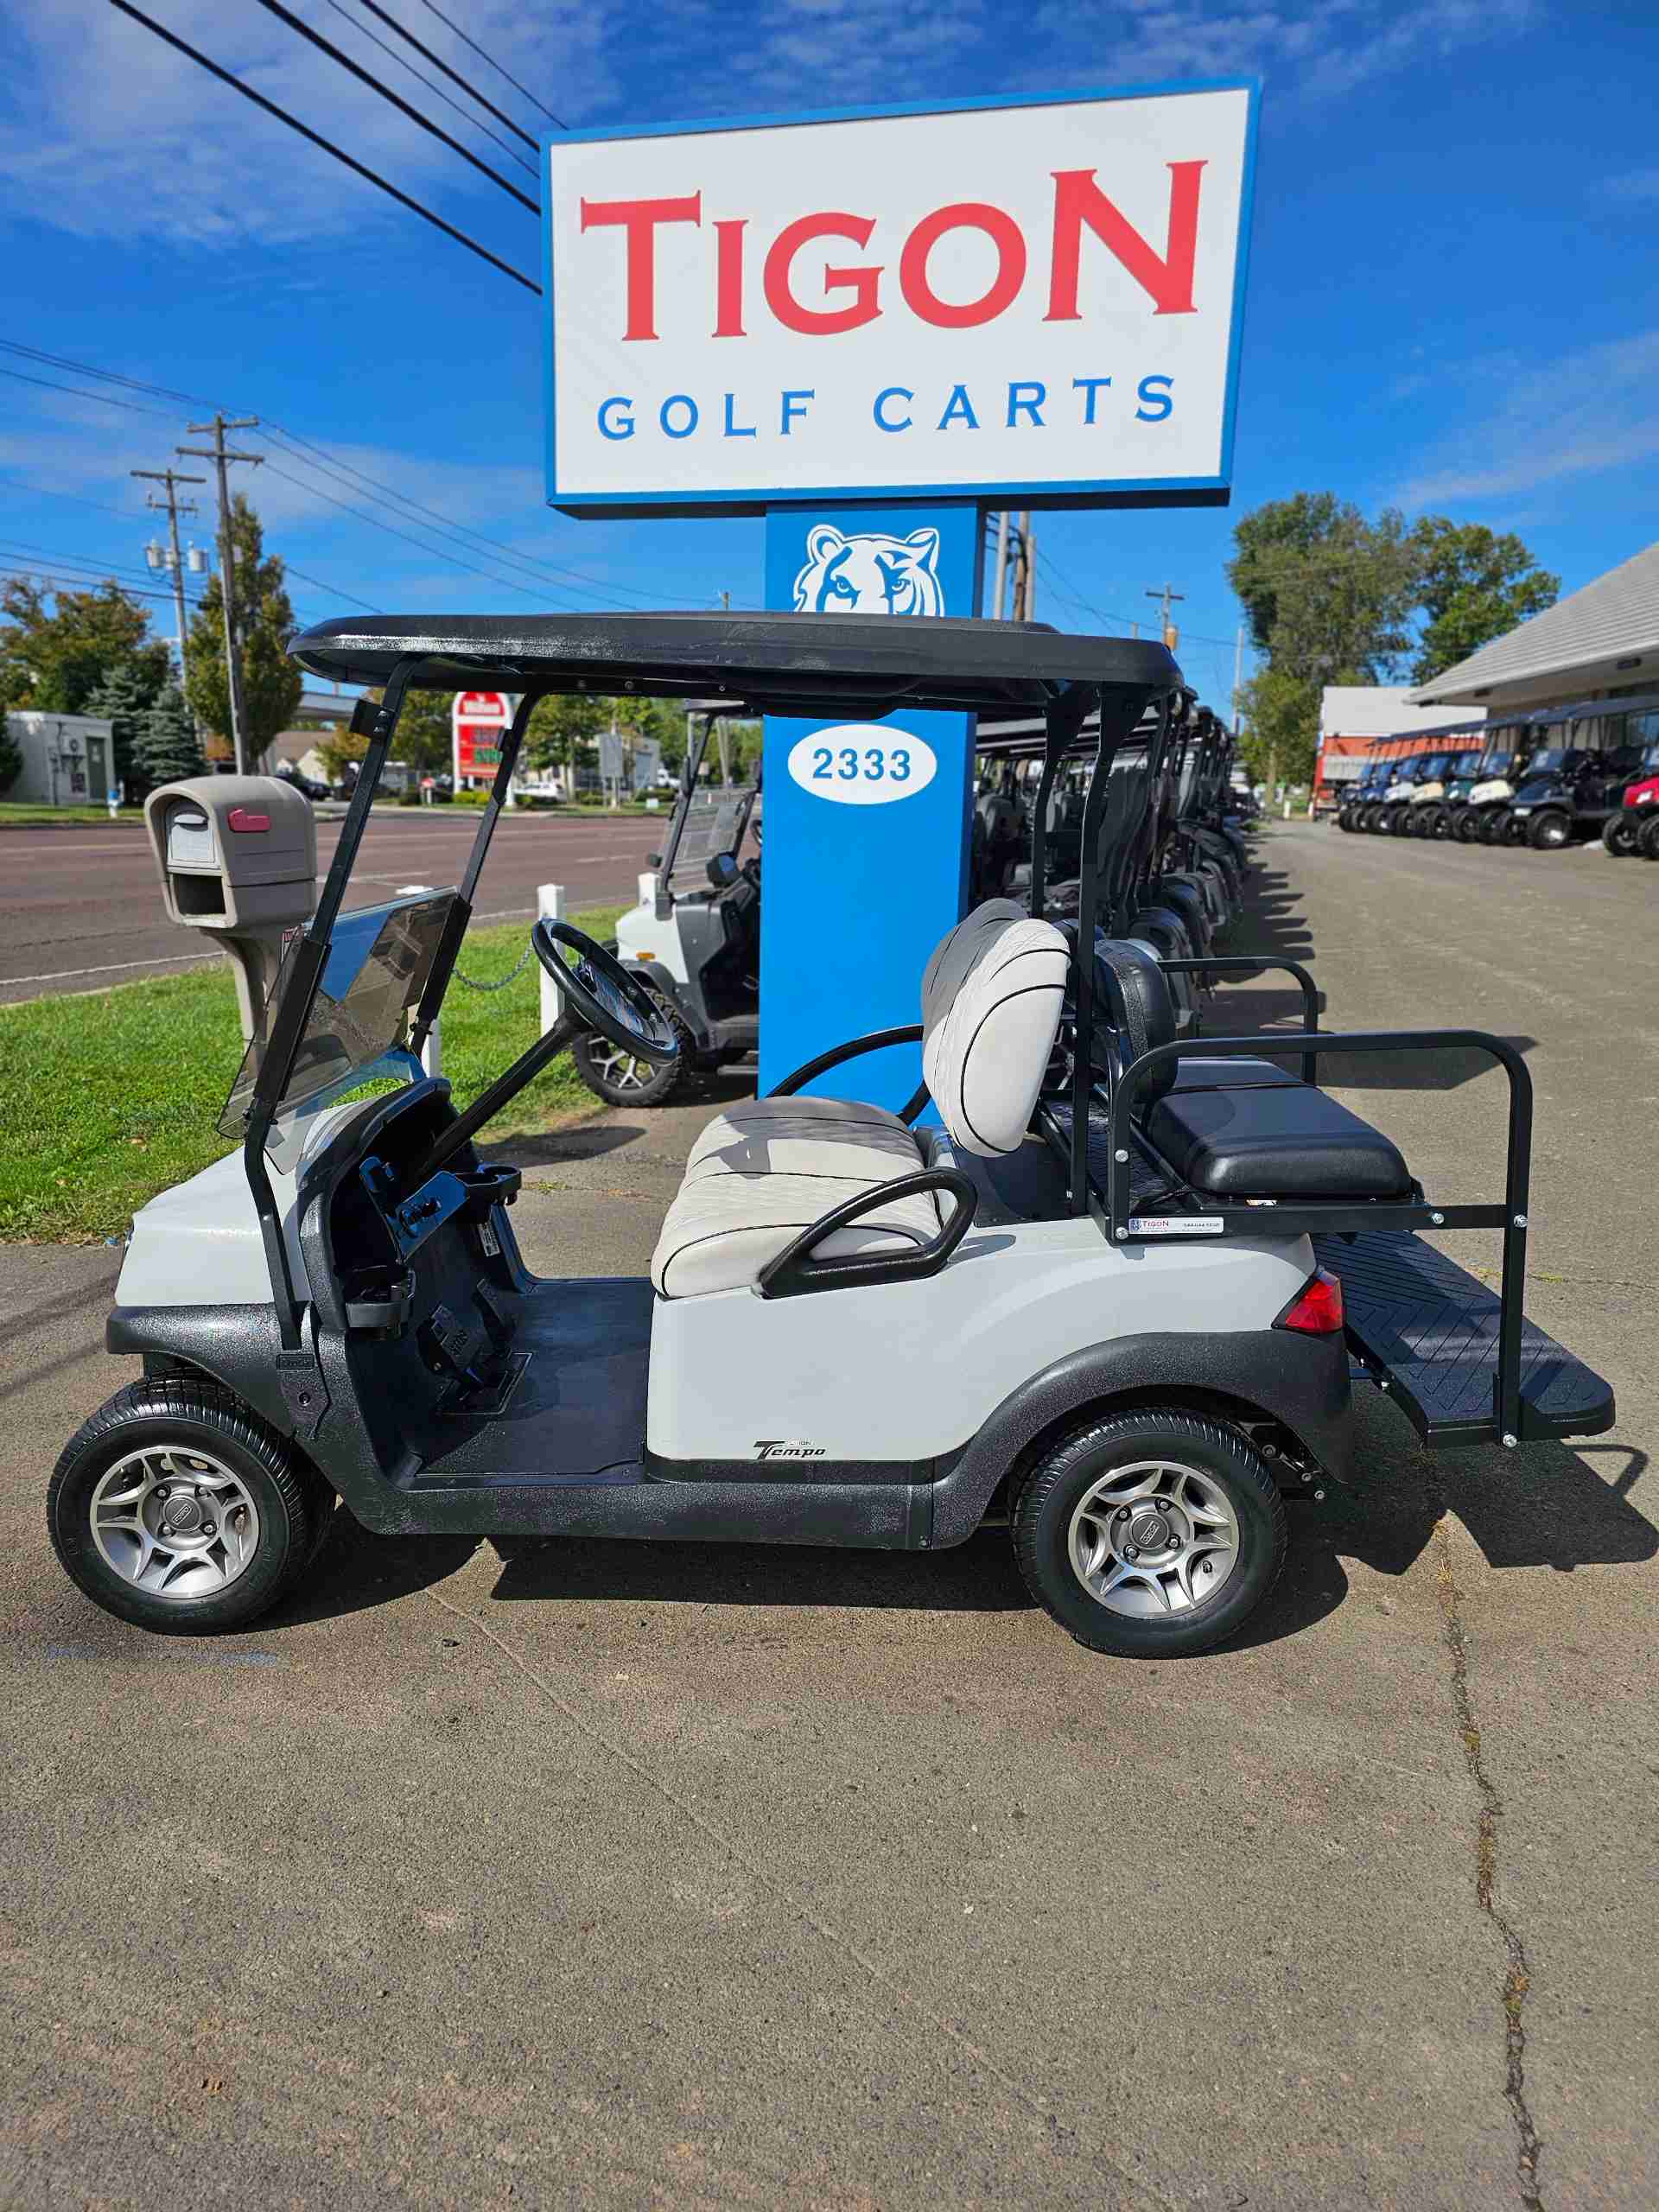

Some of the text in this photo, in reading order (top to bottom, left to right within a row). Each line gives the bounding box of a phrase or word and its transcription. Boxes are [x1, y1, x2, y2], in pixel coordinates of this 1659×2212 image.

[581, 160, 1208, 340] TIGON
[597, 374, 1173, 441] GOLF CARTS
[812, 747, 911, 781] 2333
[753, 1440, 826, 1460] Tempo
